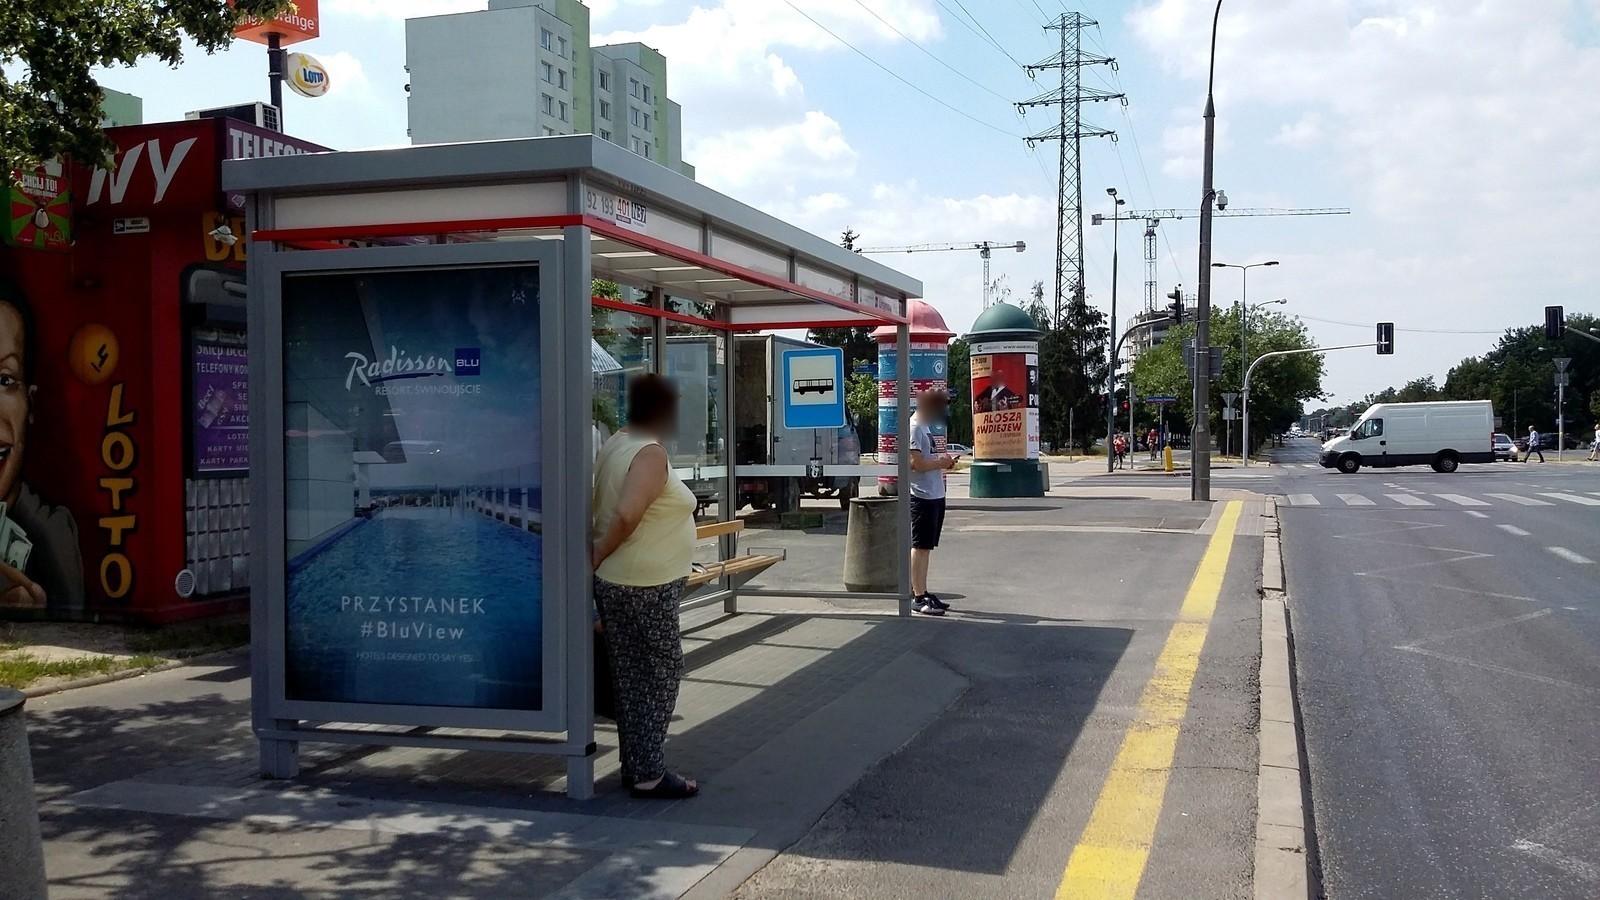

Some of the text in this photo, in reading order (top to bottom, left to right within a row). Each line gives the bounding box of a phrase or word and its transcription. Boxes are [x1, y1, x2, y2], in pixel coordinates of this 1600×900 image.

[303, 68, 324, 84] LOTTO
[587, 191, 597, 210] 92
[601, 195, 614, 216] 193
[617, 198, 630, 217] 401
[632, 202, 646, 223] N37
[196, 362, 233, 374] TELEFONY
[344, 344, 480, 392] Radisson BLU
[983, 412, 1022, 424] ALOSZA
[976, 422, 1022, 435] AWDIEJEW
[99, 383, 136, 599] LOTTO
[341, 595, 485, 615] PRZYSTANEK
[360, 620, 464, 640] #BluView
